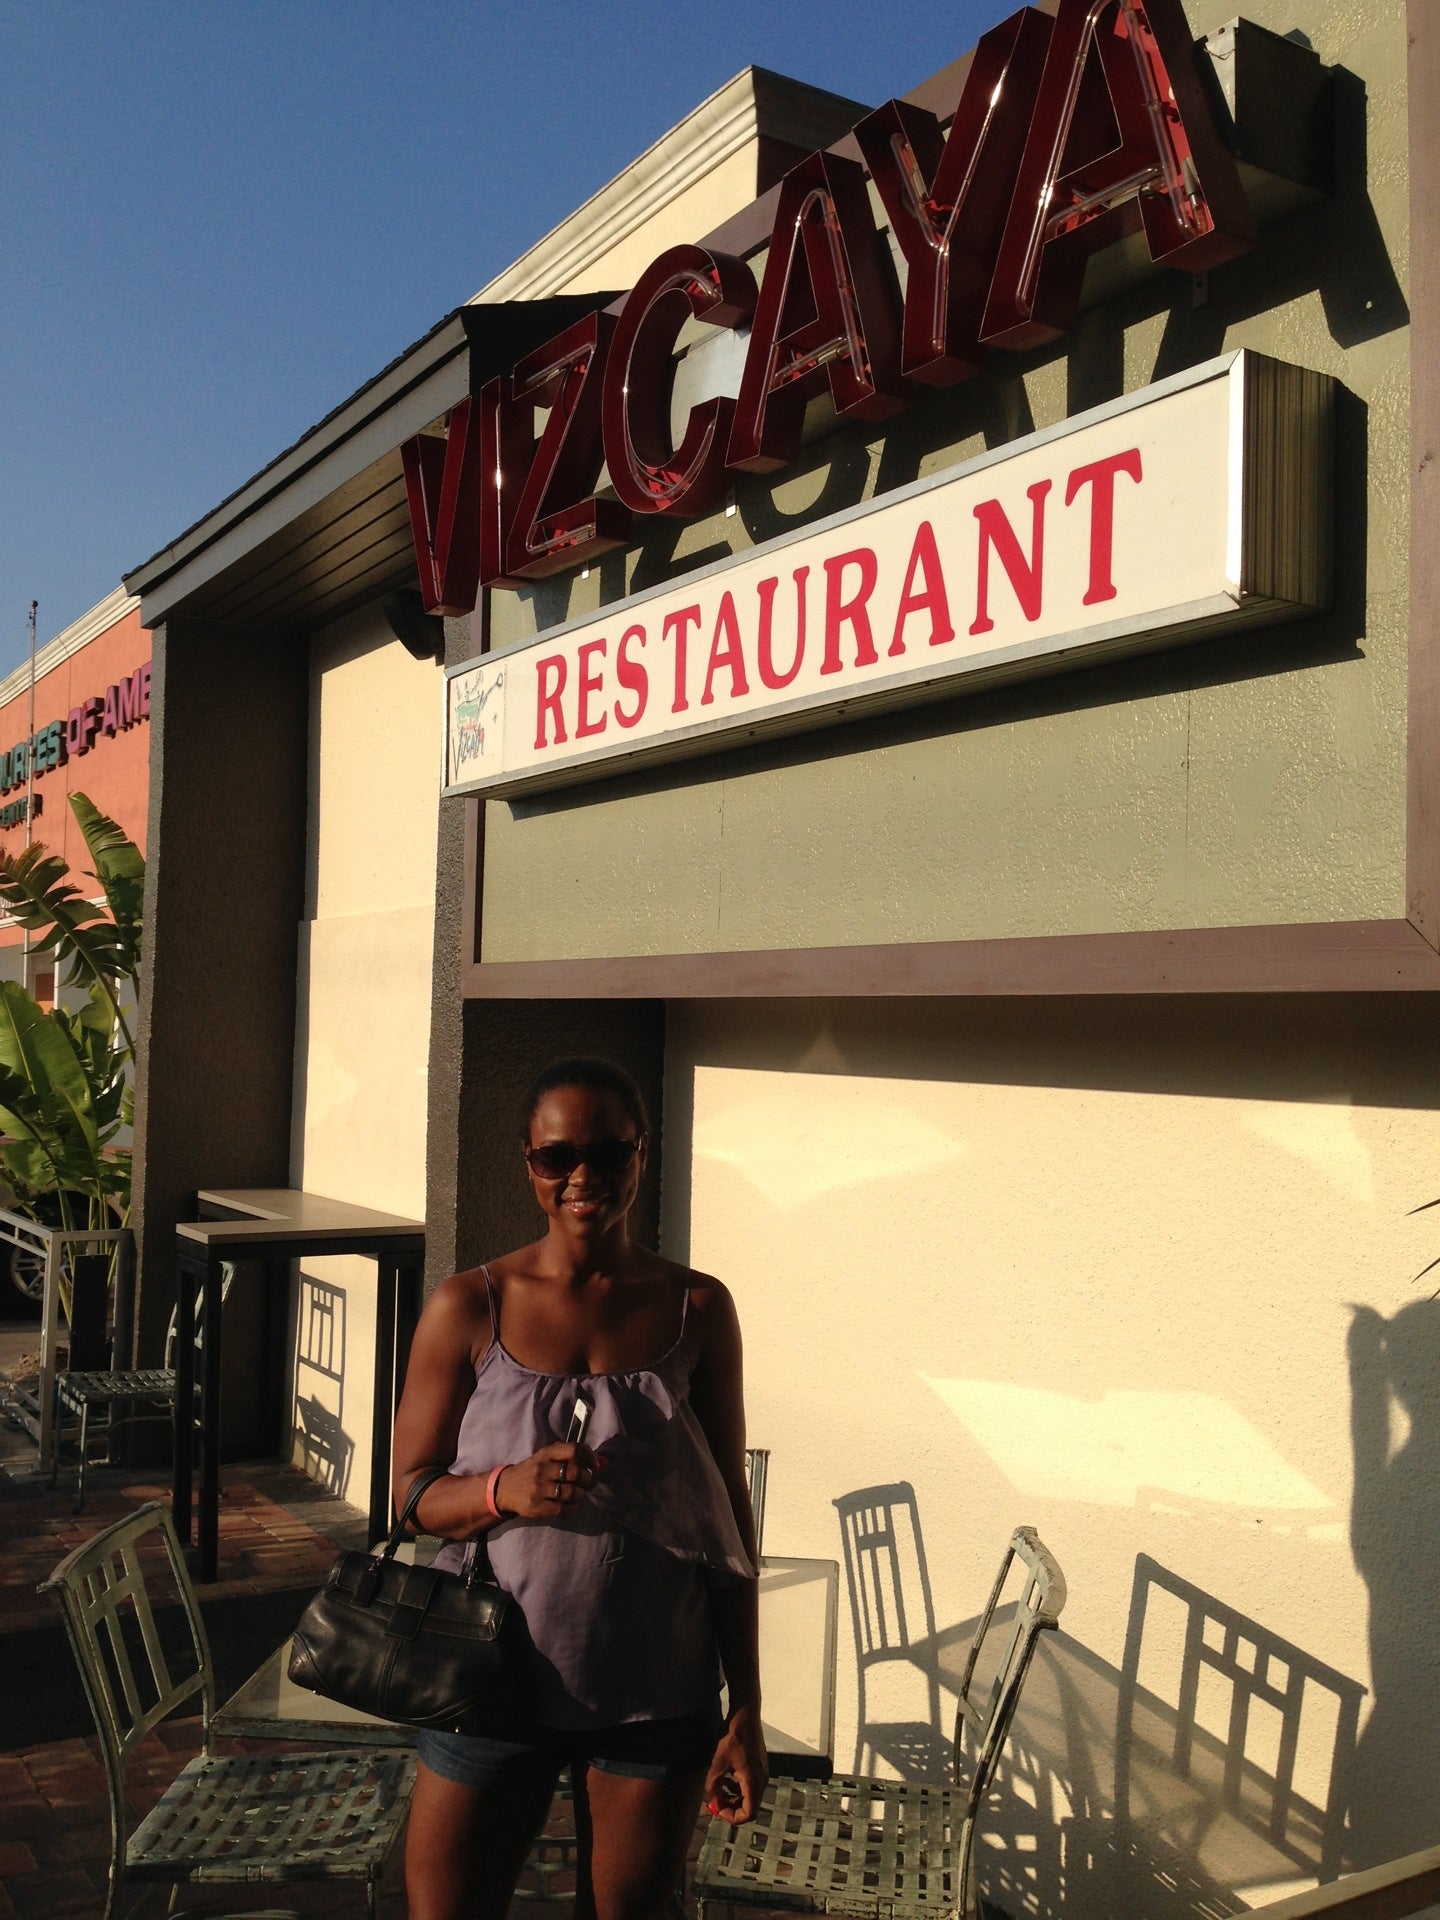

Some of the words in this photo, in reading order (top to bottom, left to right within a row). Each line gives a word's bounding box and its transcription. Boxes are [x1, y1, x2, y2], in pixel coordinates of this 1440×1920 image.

[401, 0, 1230, 616] VIZCAYA
[66, 697, 100, 755] OF
[533, 447, 1144, 751] RESTAURANT
